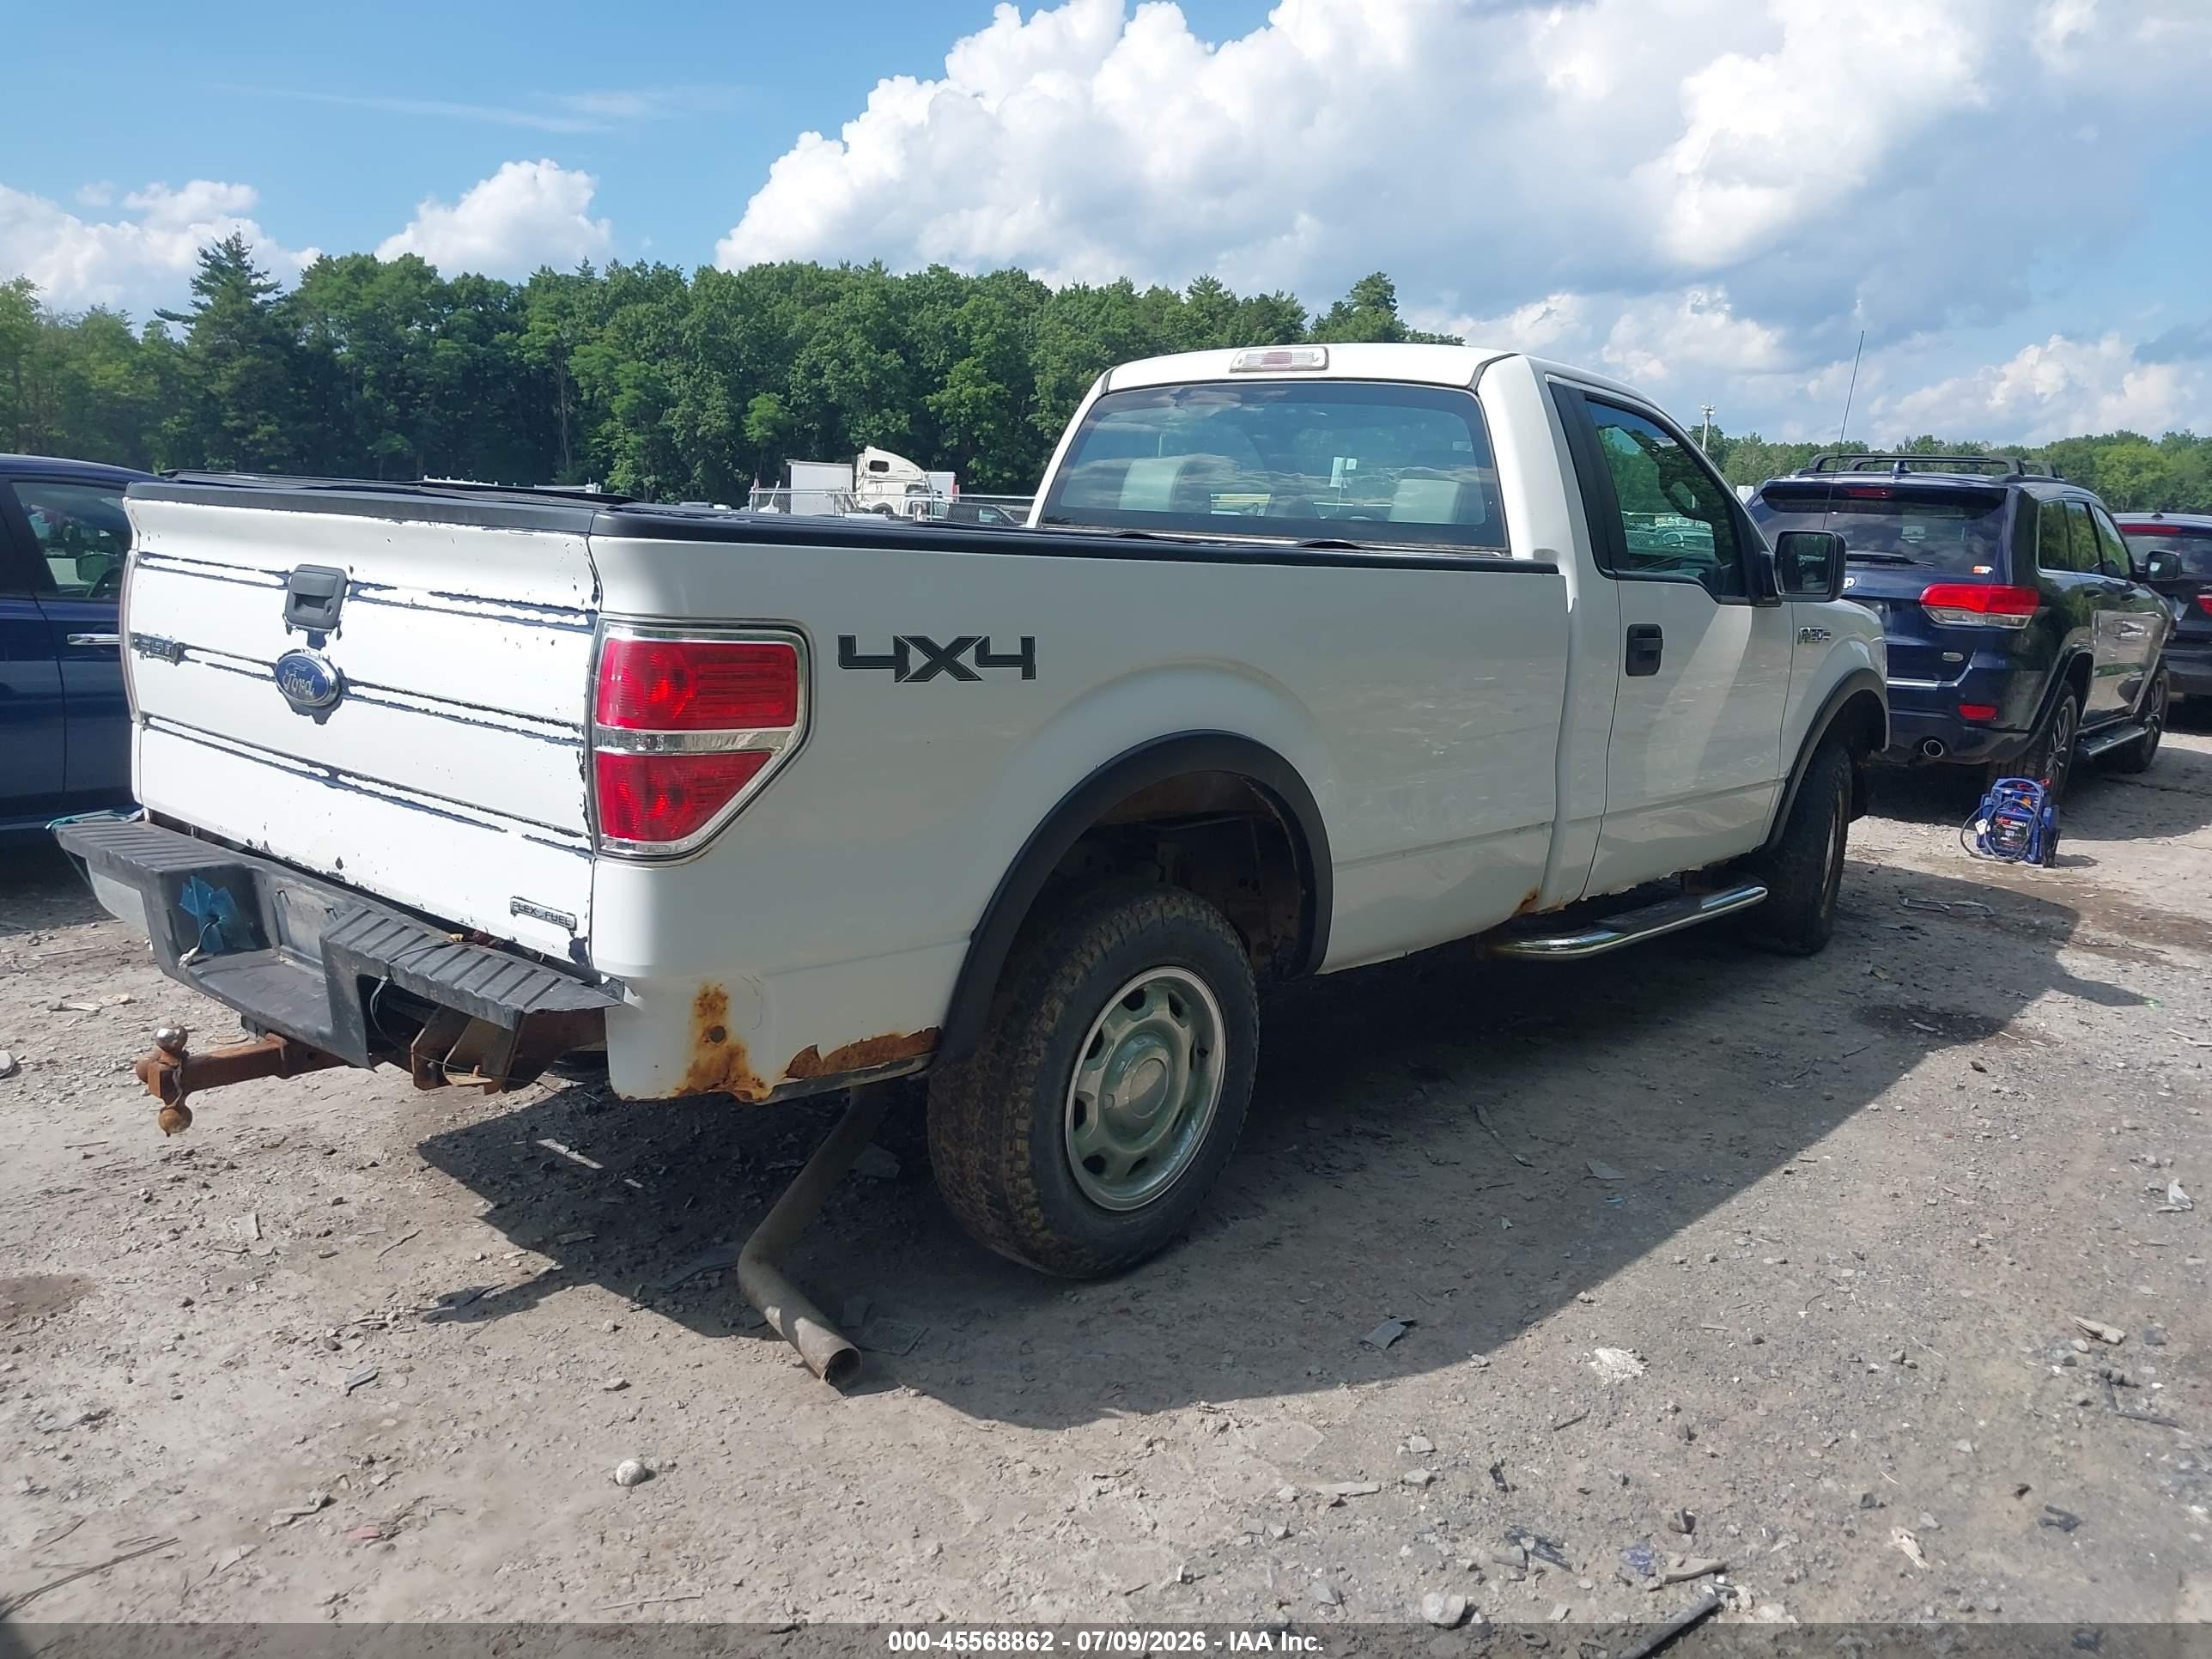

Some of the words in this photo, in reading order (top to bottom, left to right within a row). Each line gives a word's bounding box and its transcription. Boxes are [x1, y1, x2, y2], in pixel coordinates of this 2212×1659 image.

[282, 661, 316, 696] Ford
[512, 901, 538, 916] FLEX
[545, 911, 572, 927] FUEL
